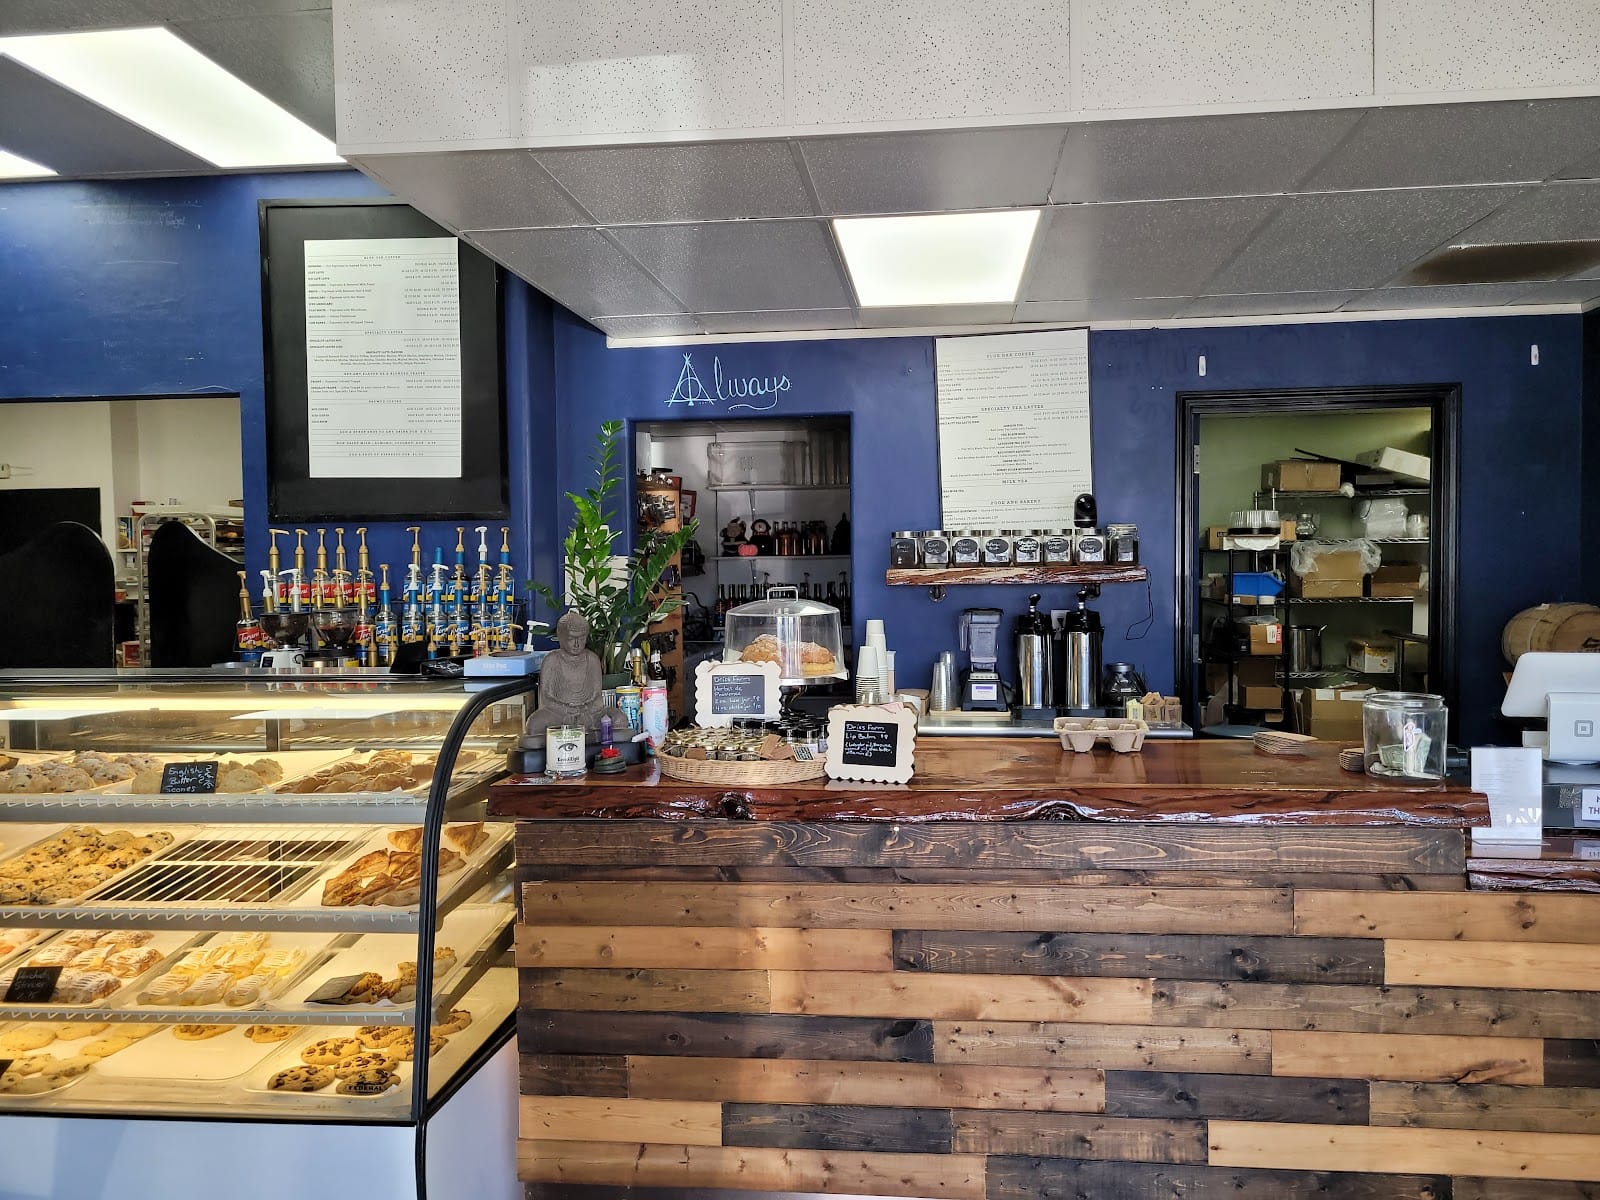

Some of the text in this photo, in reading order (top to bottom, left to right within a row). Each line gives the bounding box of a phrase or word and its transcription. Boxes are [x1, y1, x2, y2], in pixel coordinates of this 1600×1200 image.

[664, 352, 793, 411] Always
[169, 766, 203, 777] English
[170, 775, 197, 785] Butter
